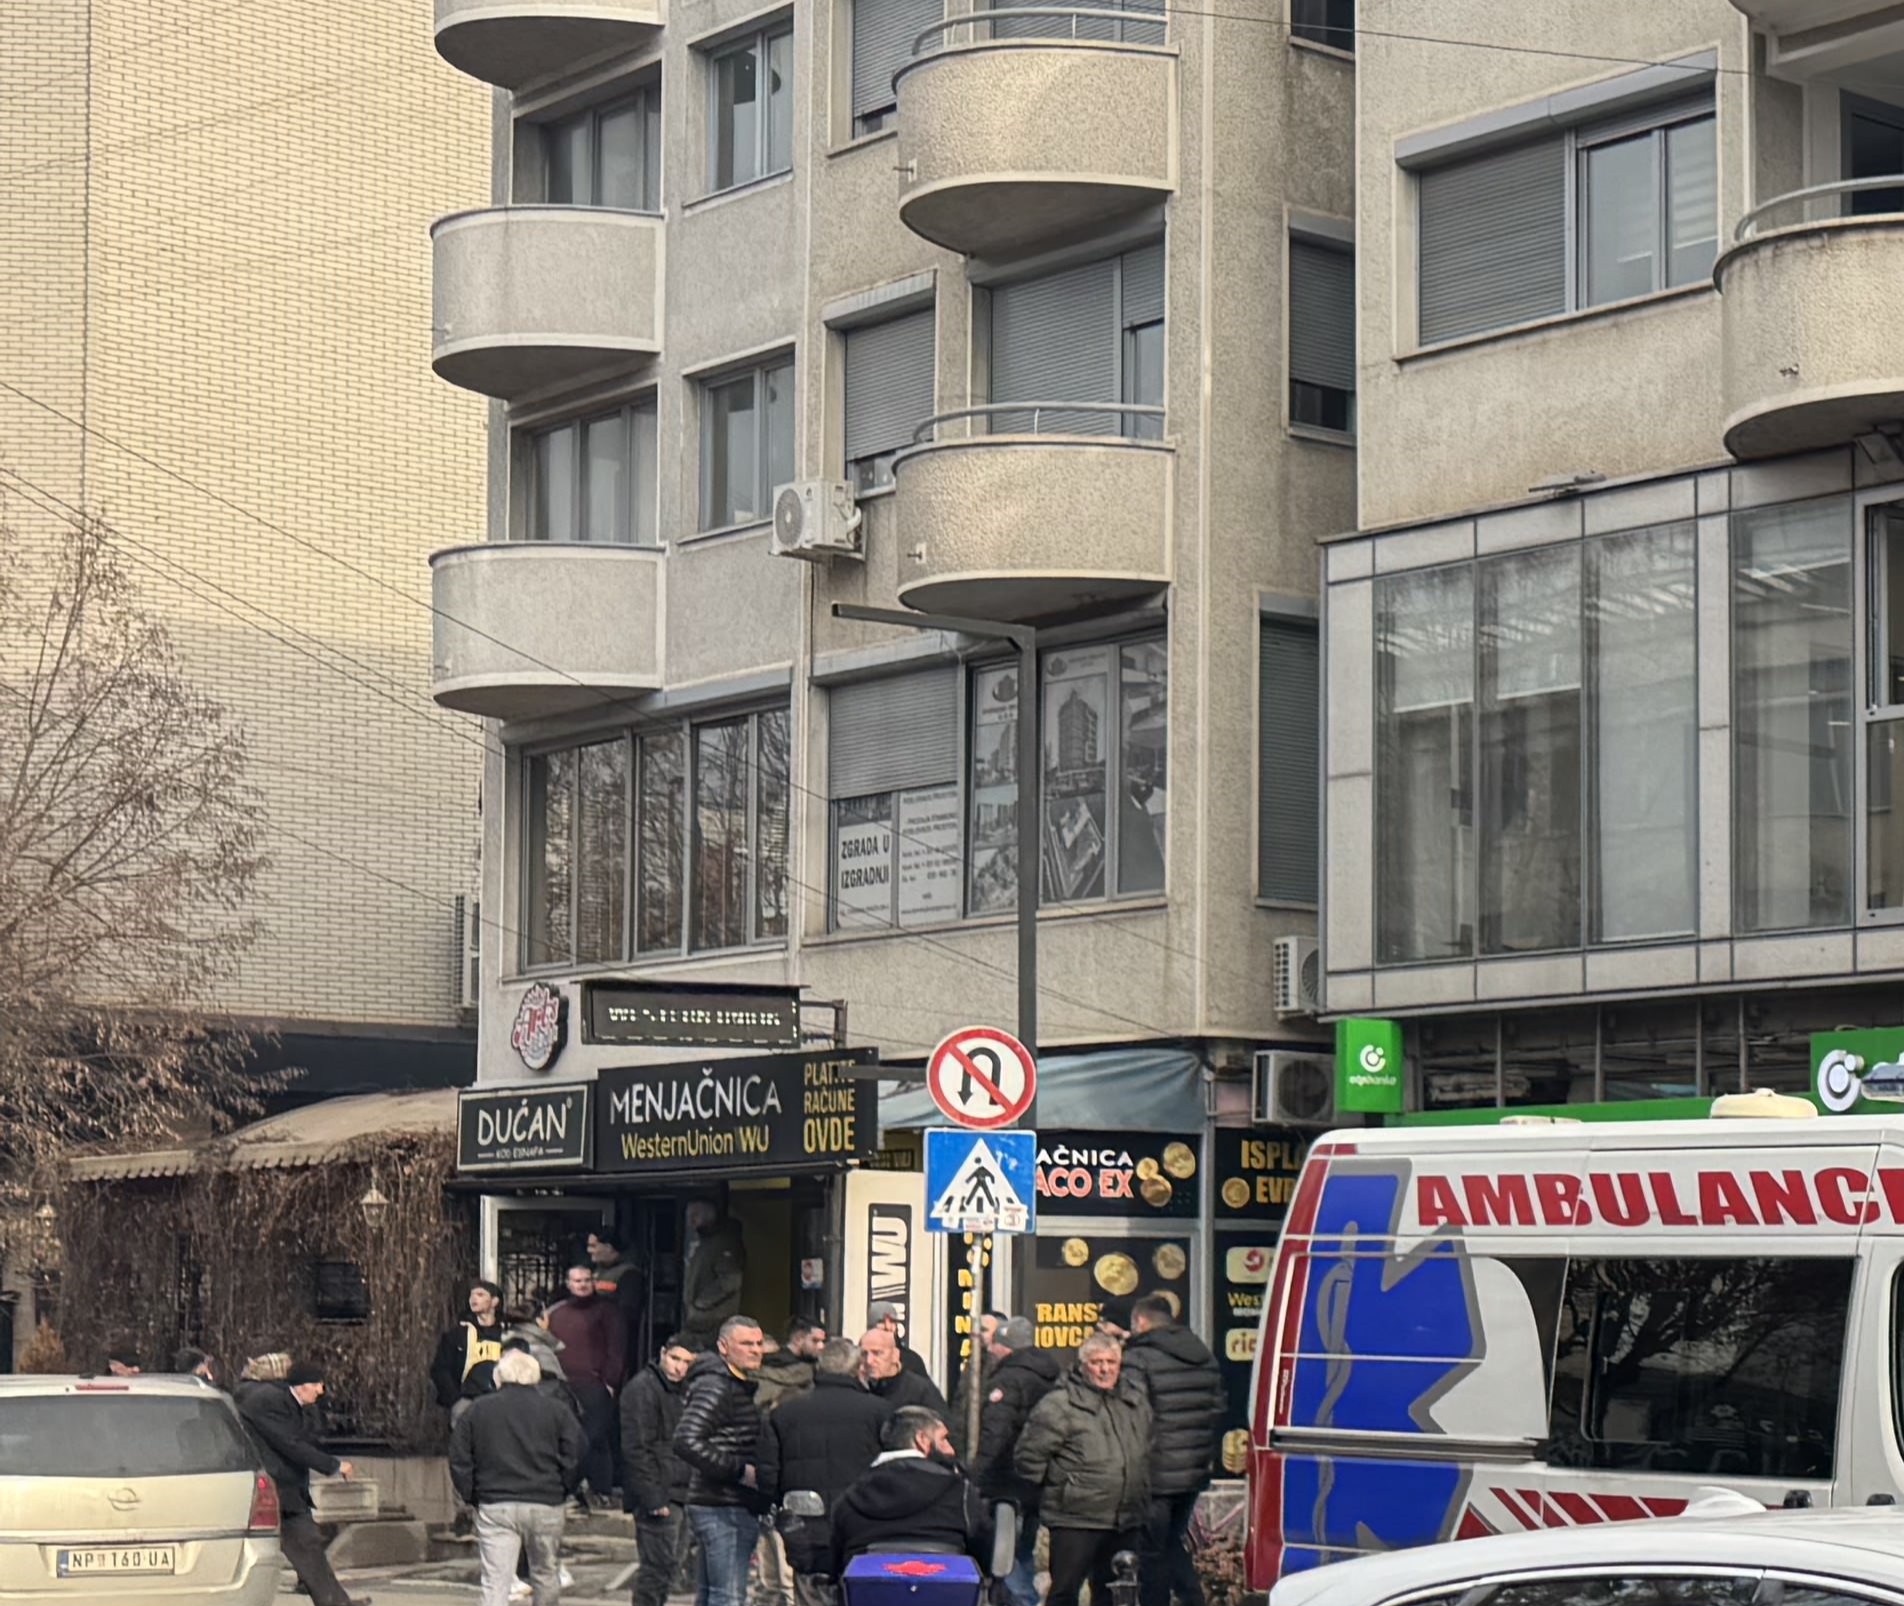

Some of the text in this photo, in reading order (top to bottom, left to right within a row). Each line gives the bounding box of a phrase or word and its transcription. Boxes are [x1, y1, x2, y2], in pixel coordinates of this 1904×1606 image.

[841, 835, 879, 859] ZGRADA
[883, 834, 890, 852] U
[841, 865, 889, 889] IZGRADNJI
[610, 1066, 782, 1125] MENJAČNICA
[804, 1086, 856, 1115] RAČUNE
[478, 1098, 566, 1146] DUĆAN
[804, 1116, 856, 1153] OVDE
[739, 1124, 769, 1153] WU
[1035, 1143, 1134, 1167] AČNICA
[1098, 1168, 1134, 1199] EX
[73, 1552, 94, 1568] NP
[149, 1551, 169, 1567] UA
